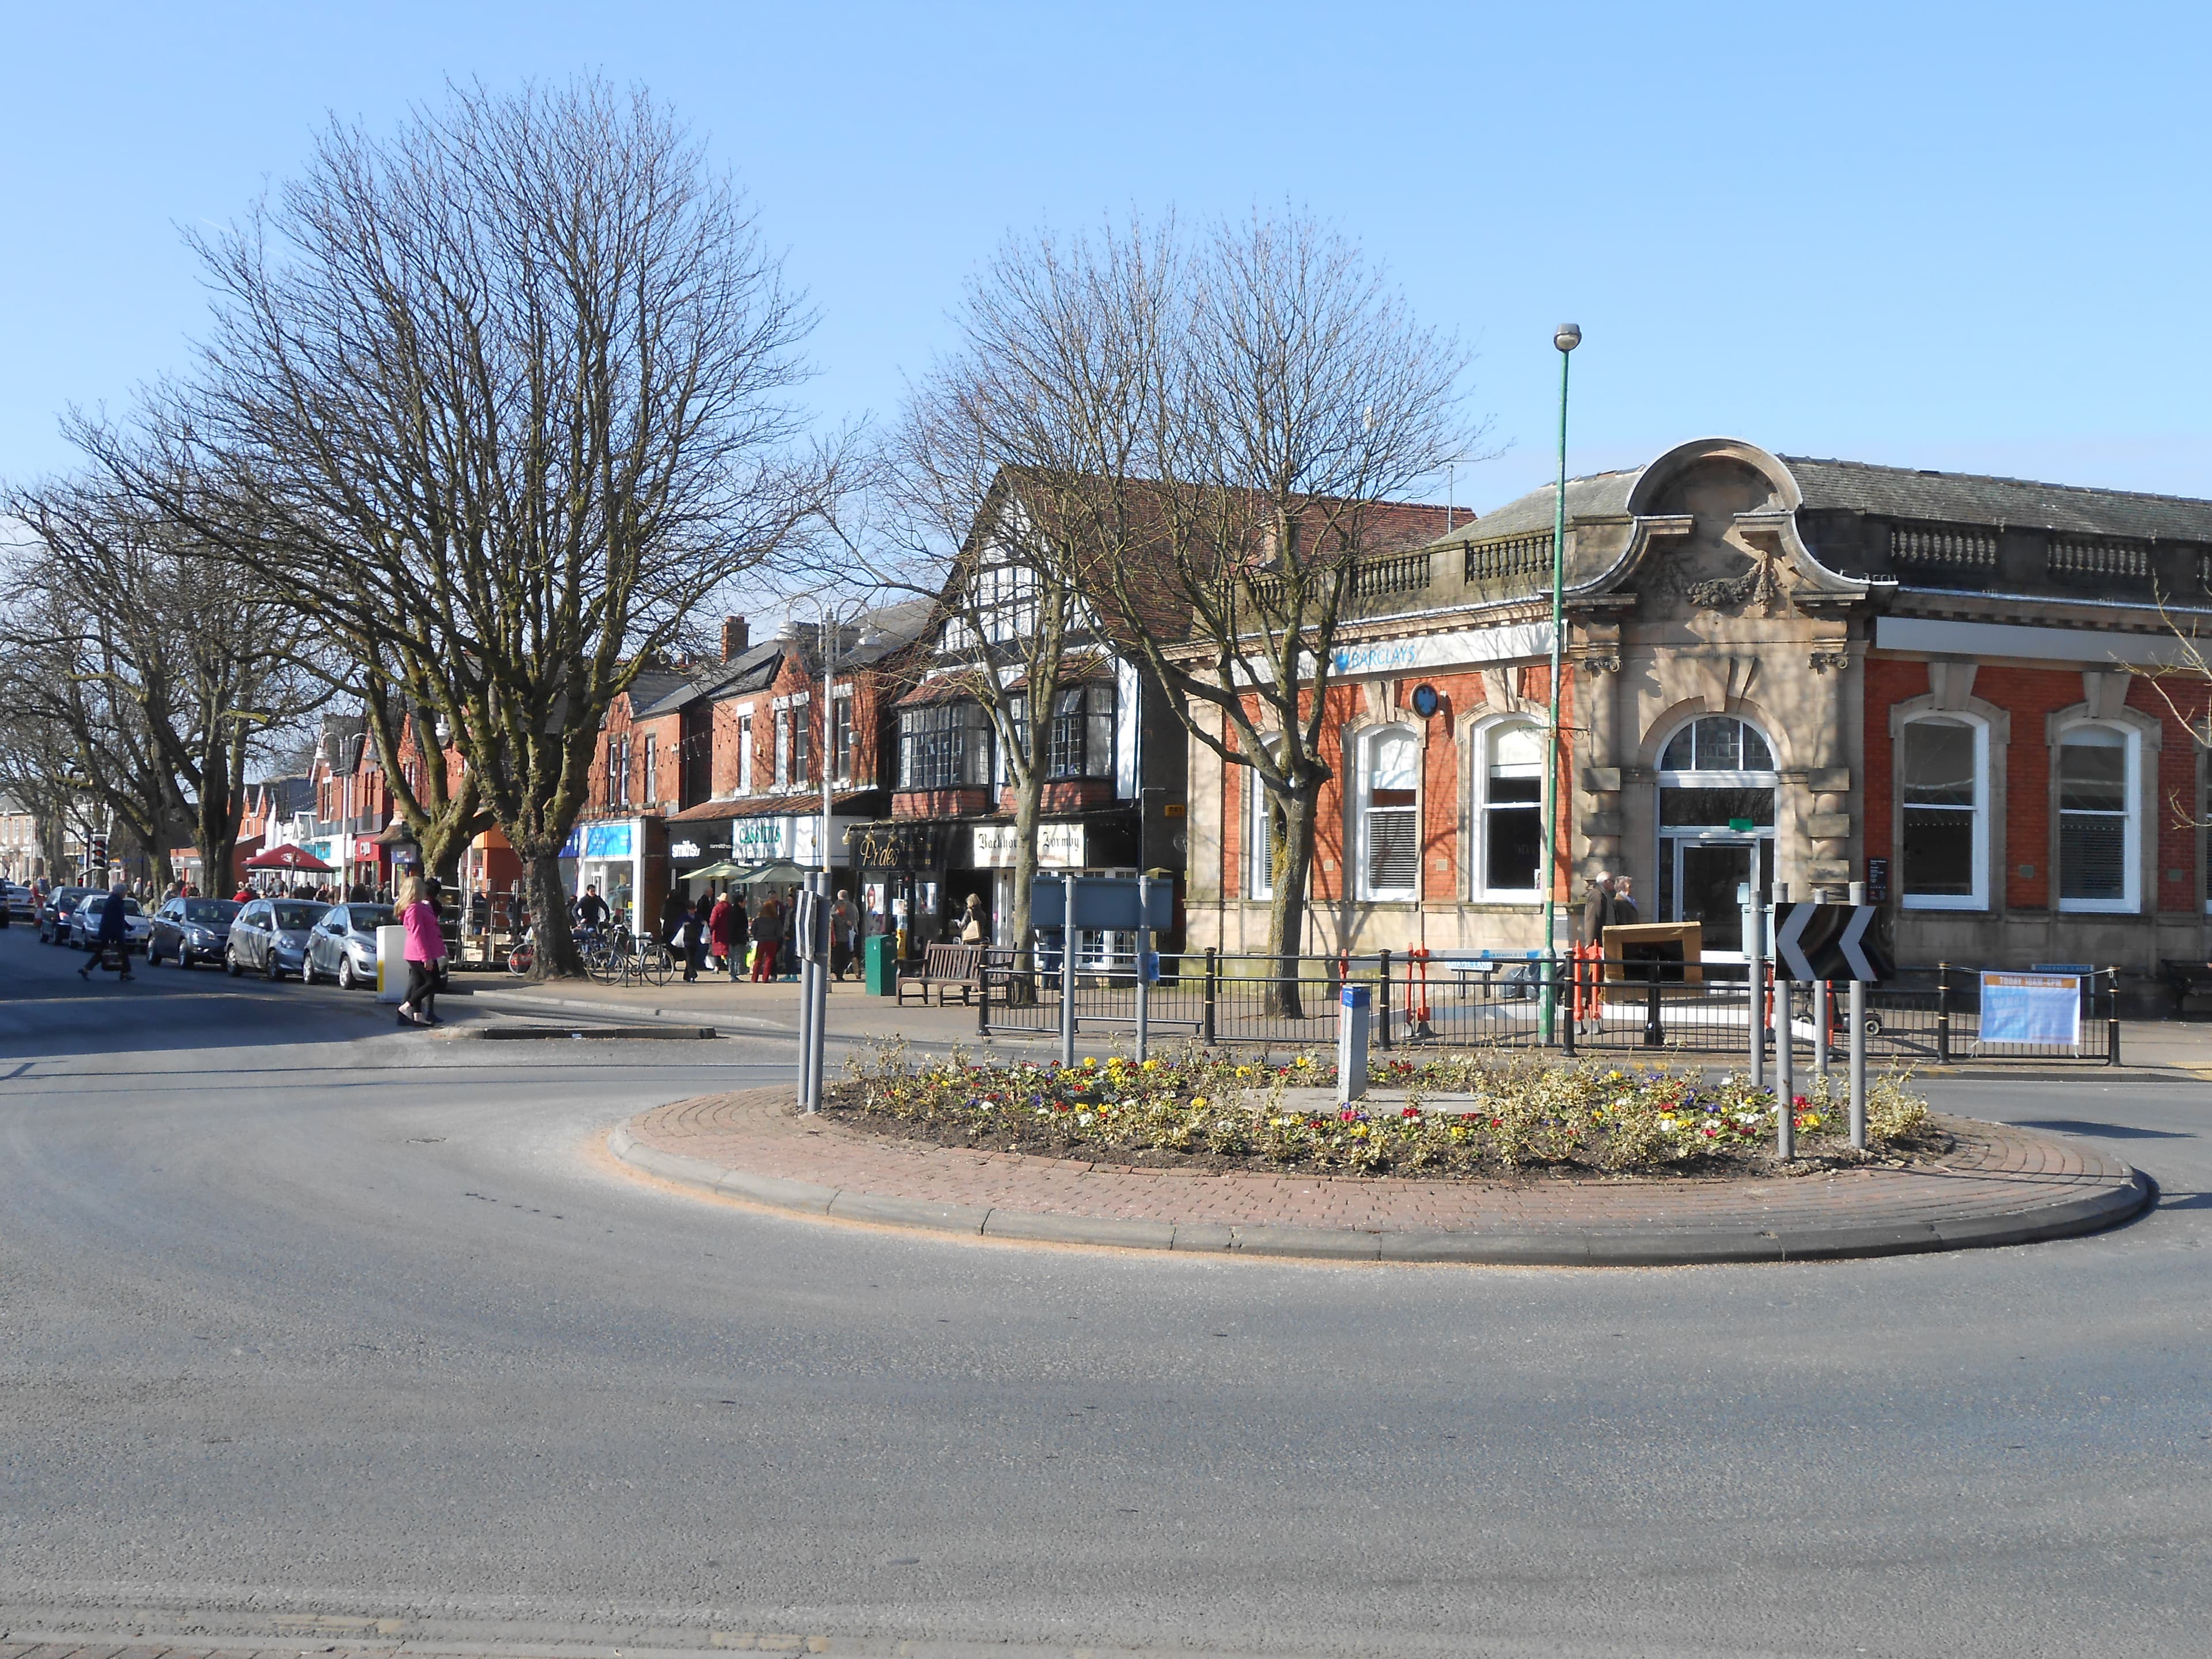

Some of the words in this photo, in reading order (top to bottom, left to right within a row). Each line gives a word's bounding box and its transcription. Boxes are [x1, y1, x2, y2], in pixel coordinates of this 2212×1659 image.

[1351, 645, 1416, 668] BARCLAYS
[978, 833, 1018, 850] Backhou
[1043, 831, 1079, 851] Formby
[1999, 976, 2022, 986] TODAY
